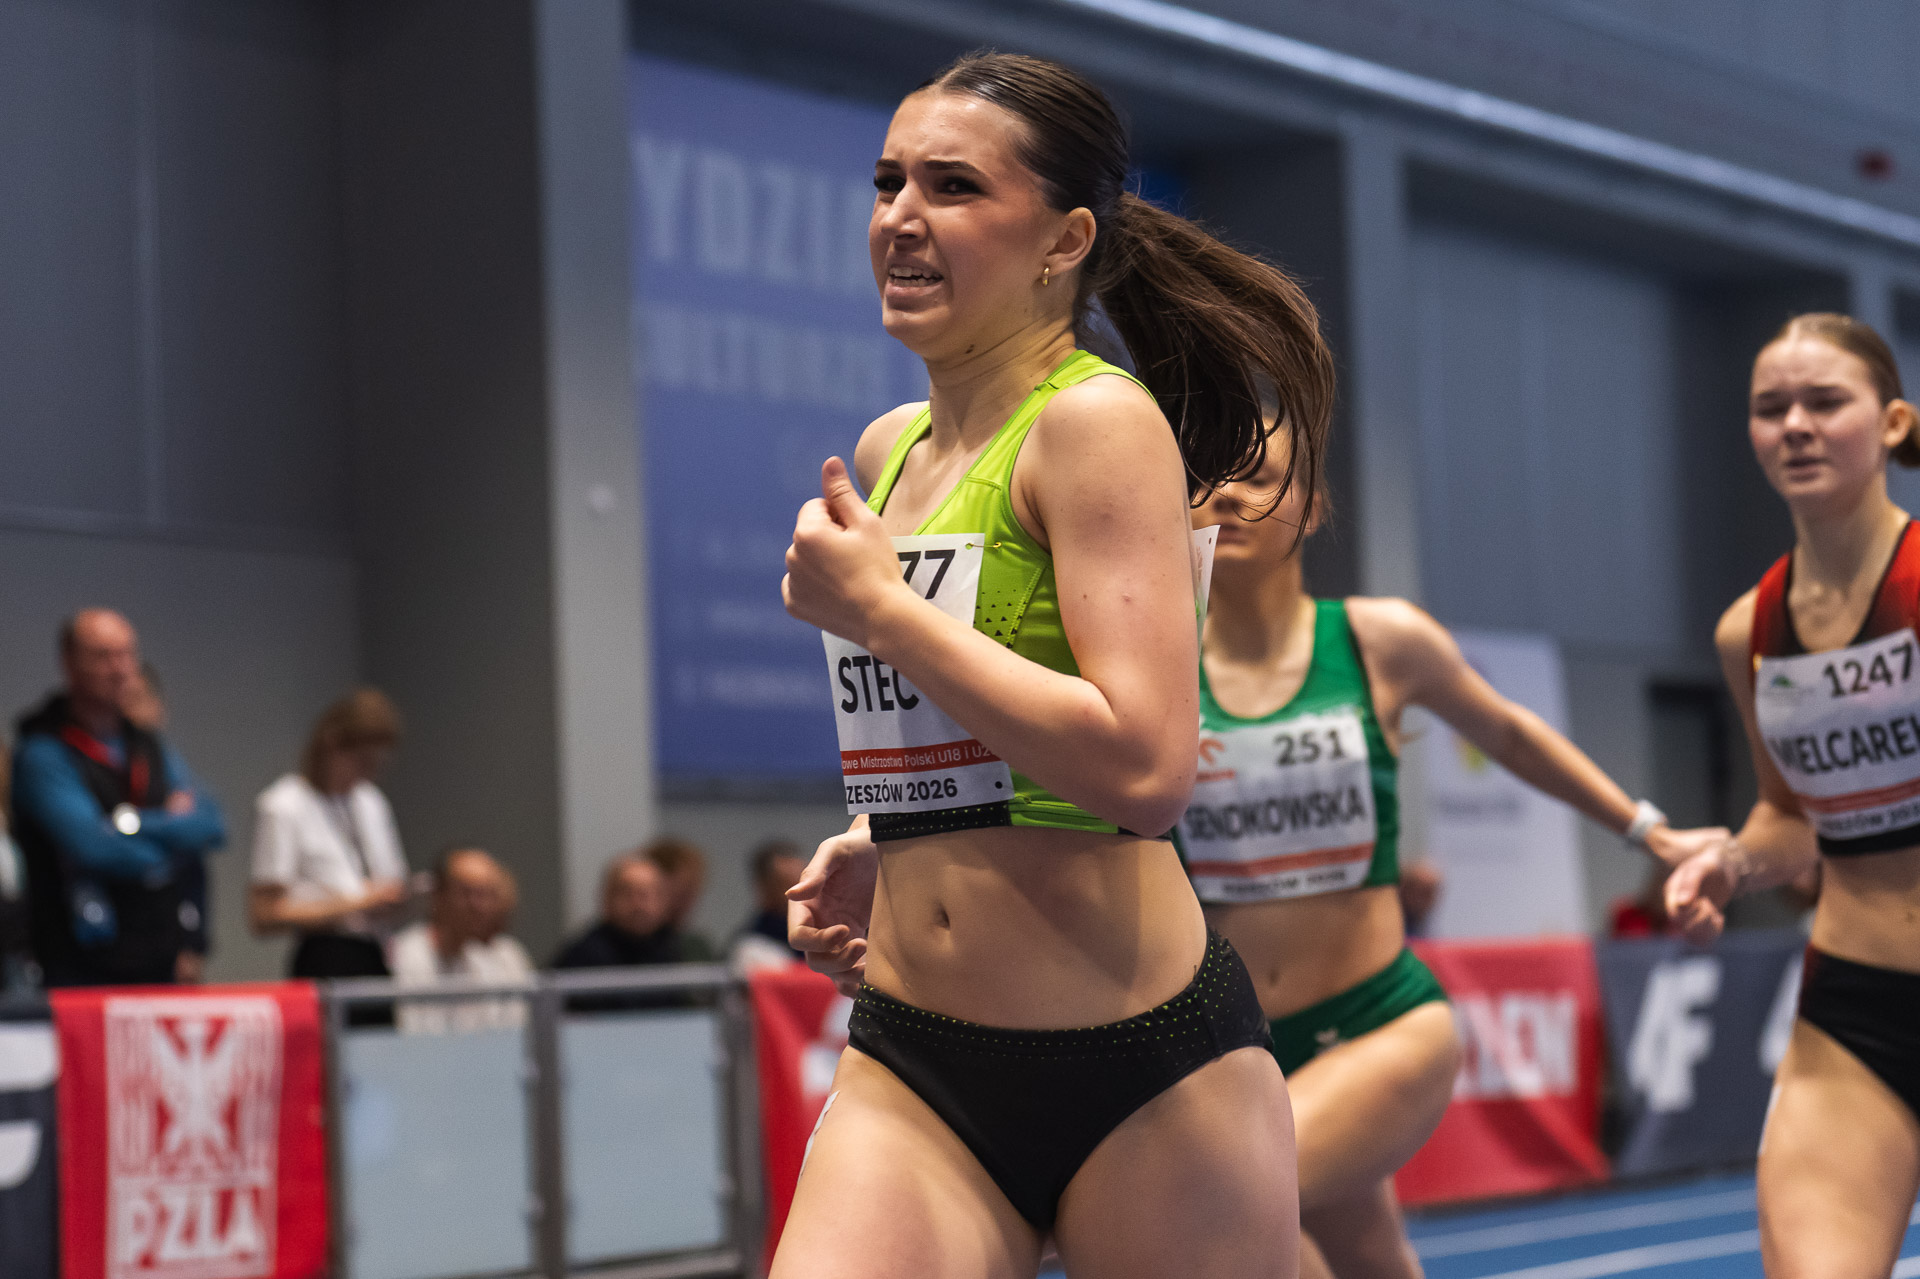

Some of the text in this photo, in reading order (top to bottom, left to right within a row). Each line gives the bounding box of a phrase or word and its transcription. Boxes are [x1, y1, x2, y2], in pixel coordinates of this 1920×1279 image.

[838, 654, 919, 713] STEC
[1823, 641, 1913, 698] 1247
[860, 757, 903, 769] Mistrzostwa
[904, 752, 936, 767] Polski
[938, 748, 961, 763] U18
[972, 744, 995, 758] U2
[1274, 728, 1346, 767] 251
[906, 778, 958, 801] 2026
